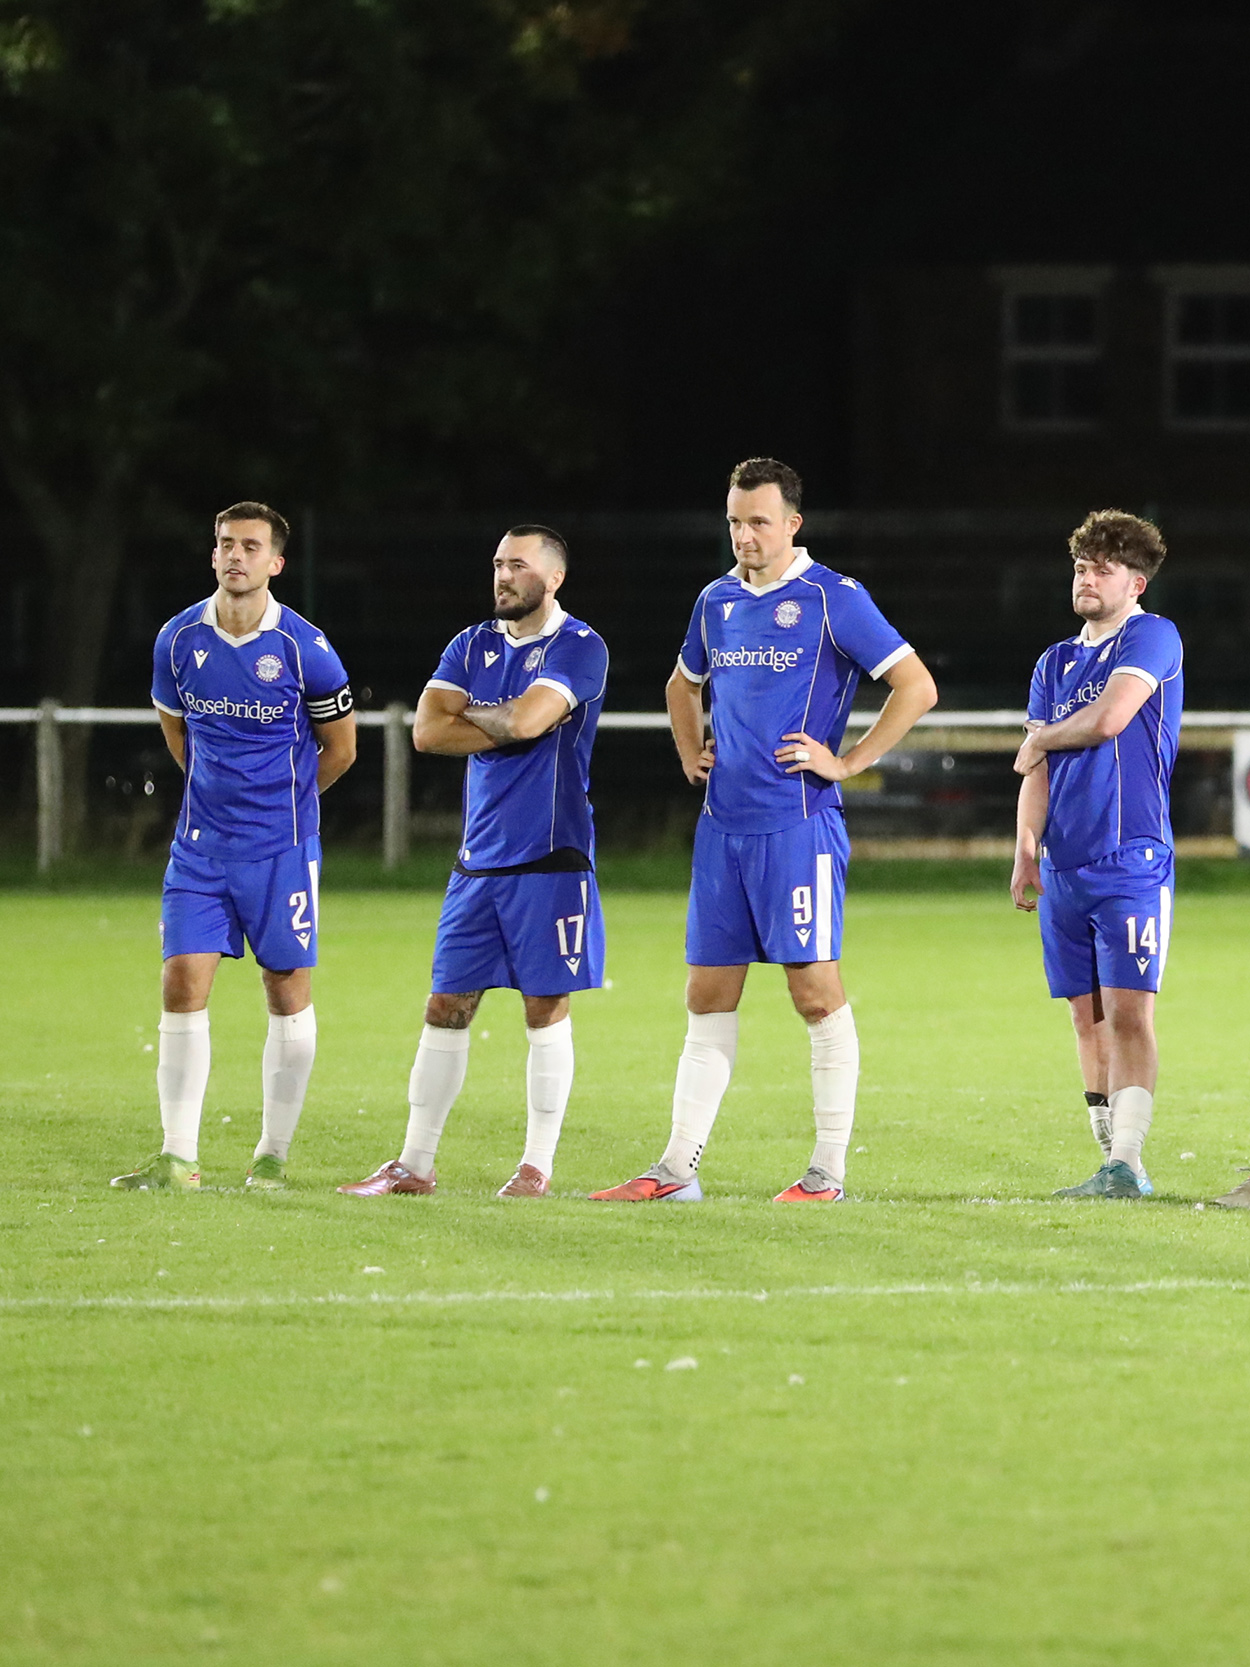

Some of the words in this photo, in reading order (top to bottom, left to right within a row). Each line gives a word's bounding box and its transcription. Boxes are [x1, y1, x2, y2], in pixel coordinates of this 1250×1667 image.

[337, 688, 353, 712] C
[289, 891, 311, 930] 2
[792, 886, 813, 924] 9
[555, 914, 584, 956] 17
[1126, 917, 1158, 955] 14
